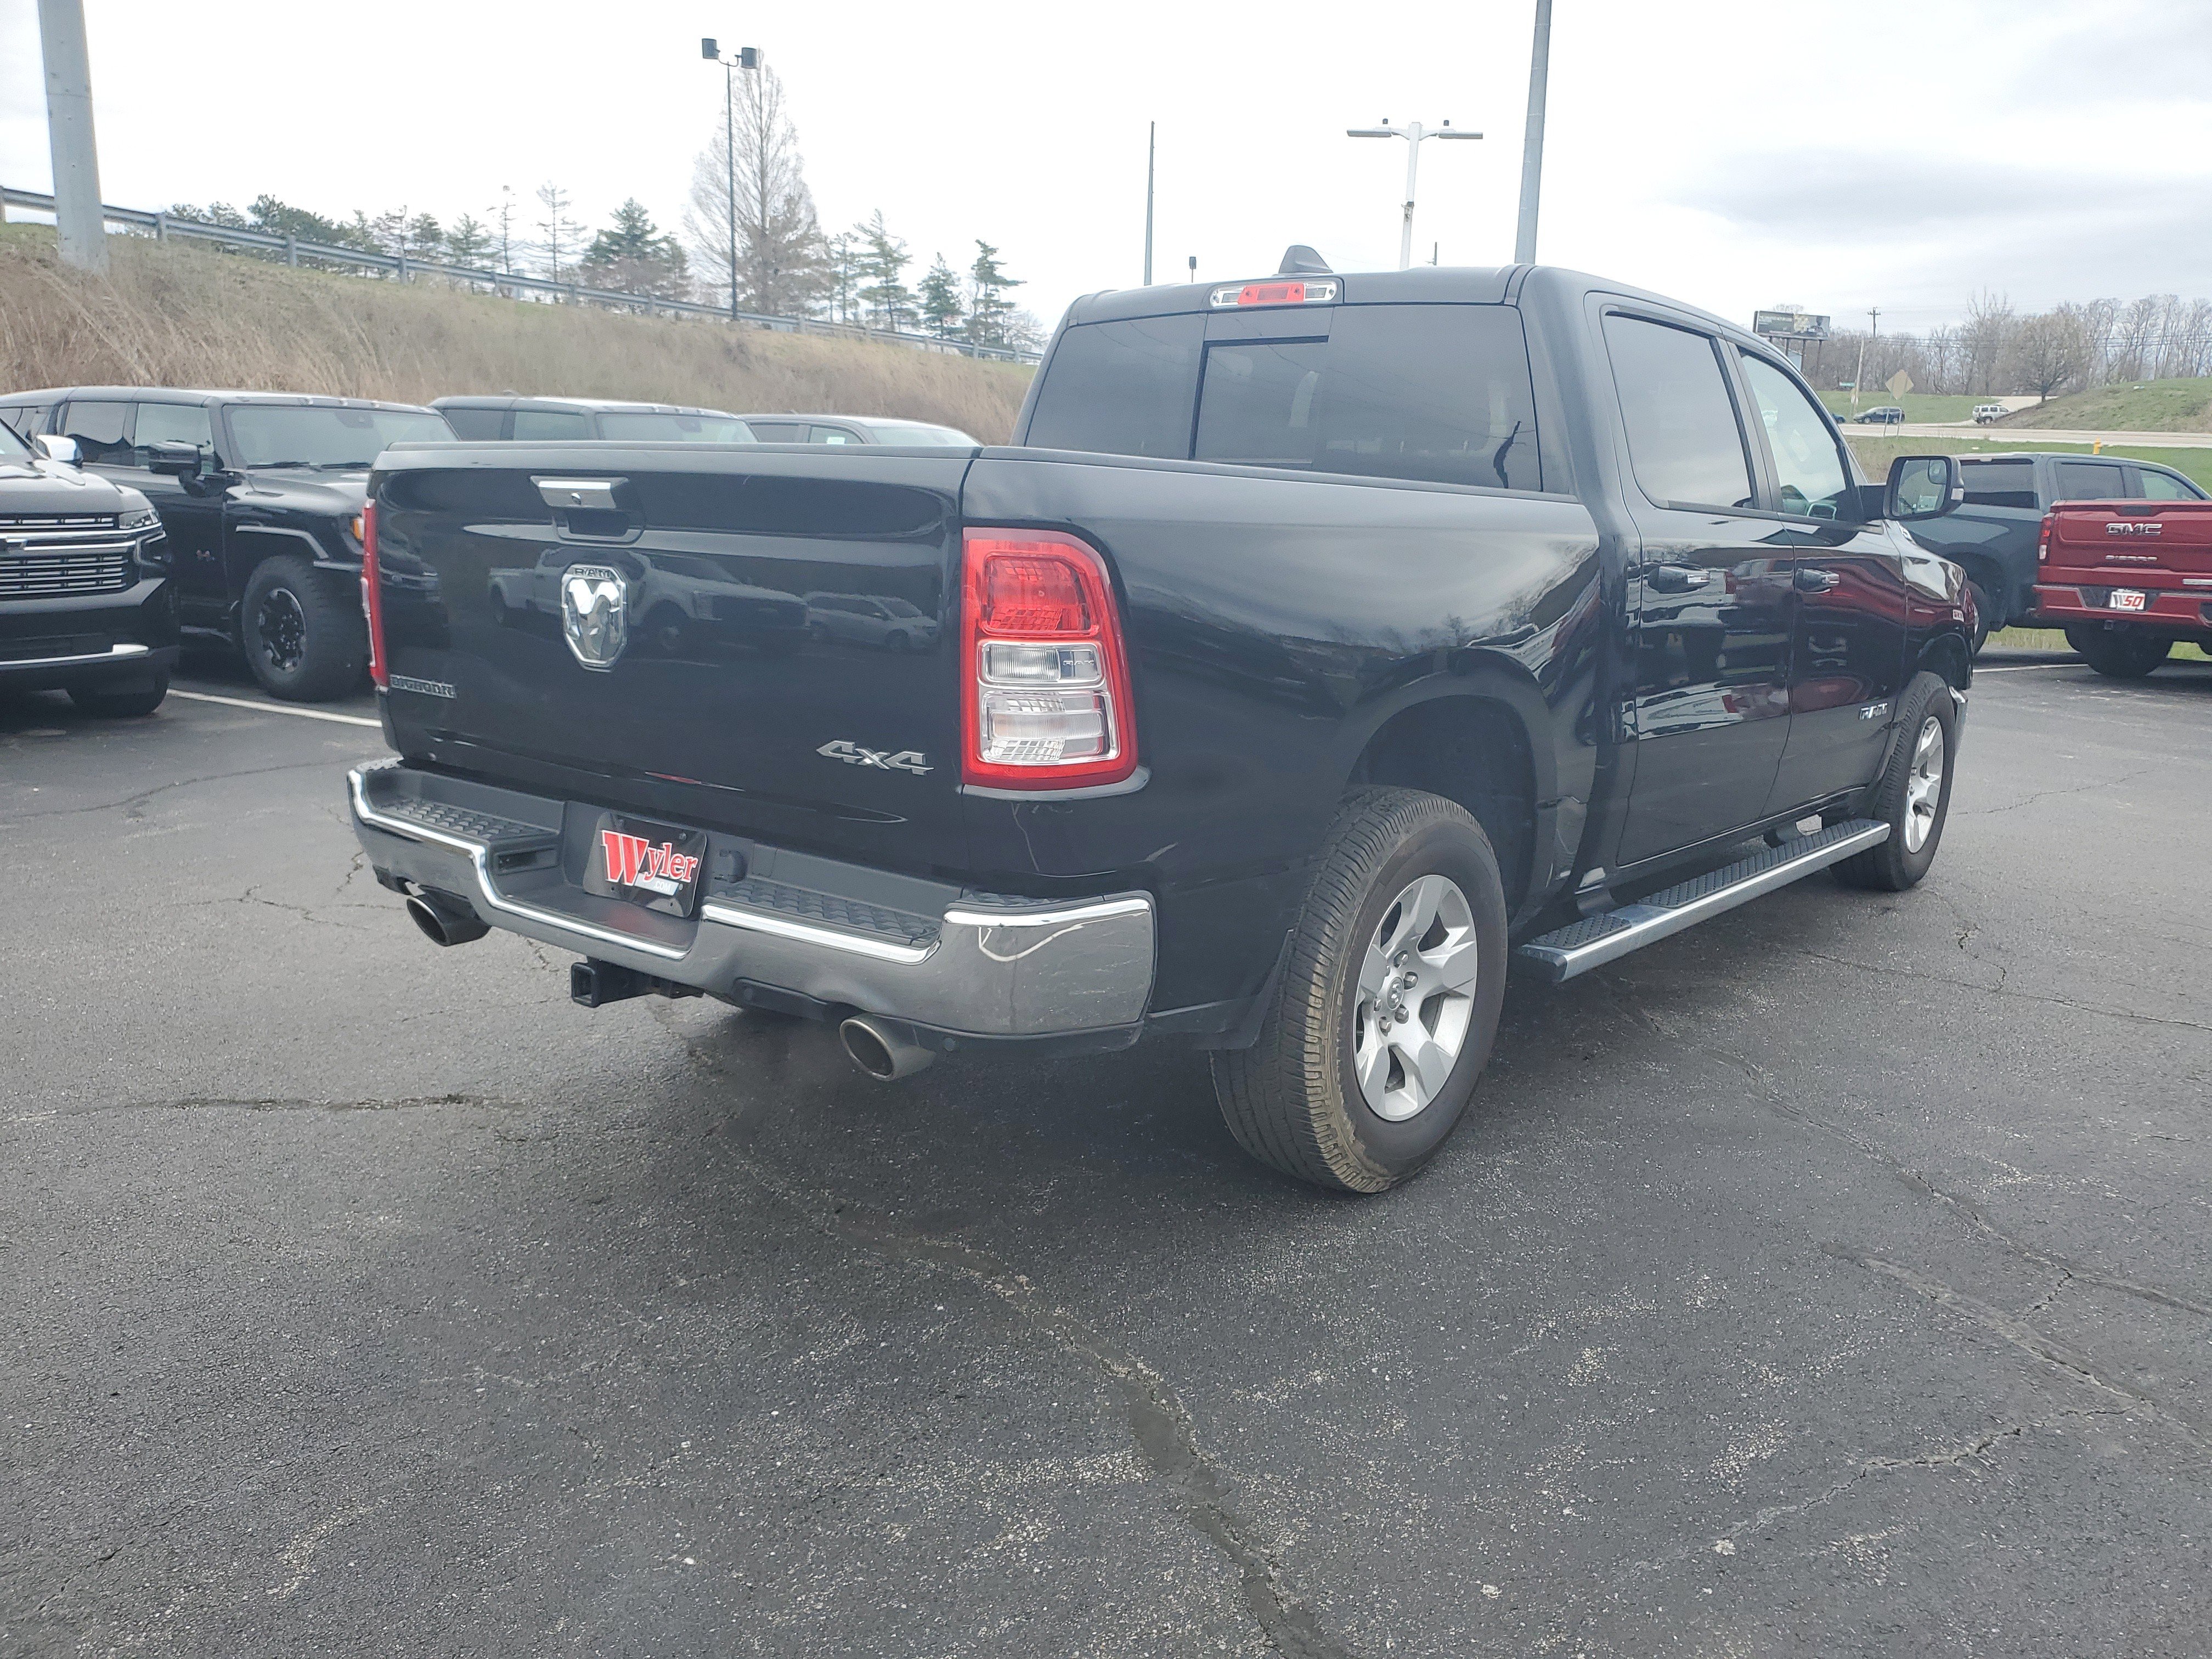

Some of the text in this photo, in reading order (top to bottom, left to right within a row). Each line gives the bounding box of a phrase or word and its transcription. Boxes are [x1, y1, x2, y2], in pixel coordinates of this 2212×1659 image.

[2106, 523, 2163, 536] GMC
[574, 568, 613, 578] RAM
[602, 830, 698, 885] Wyler
